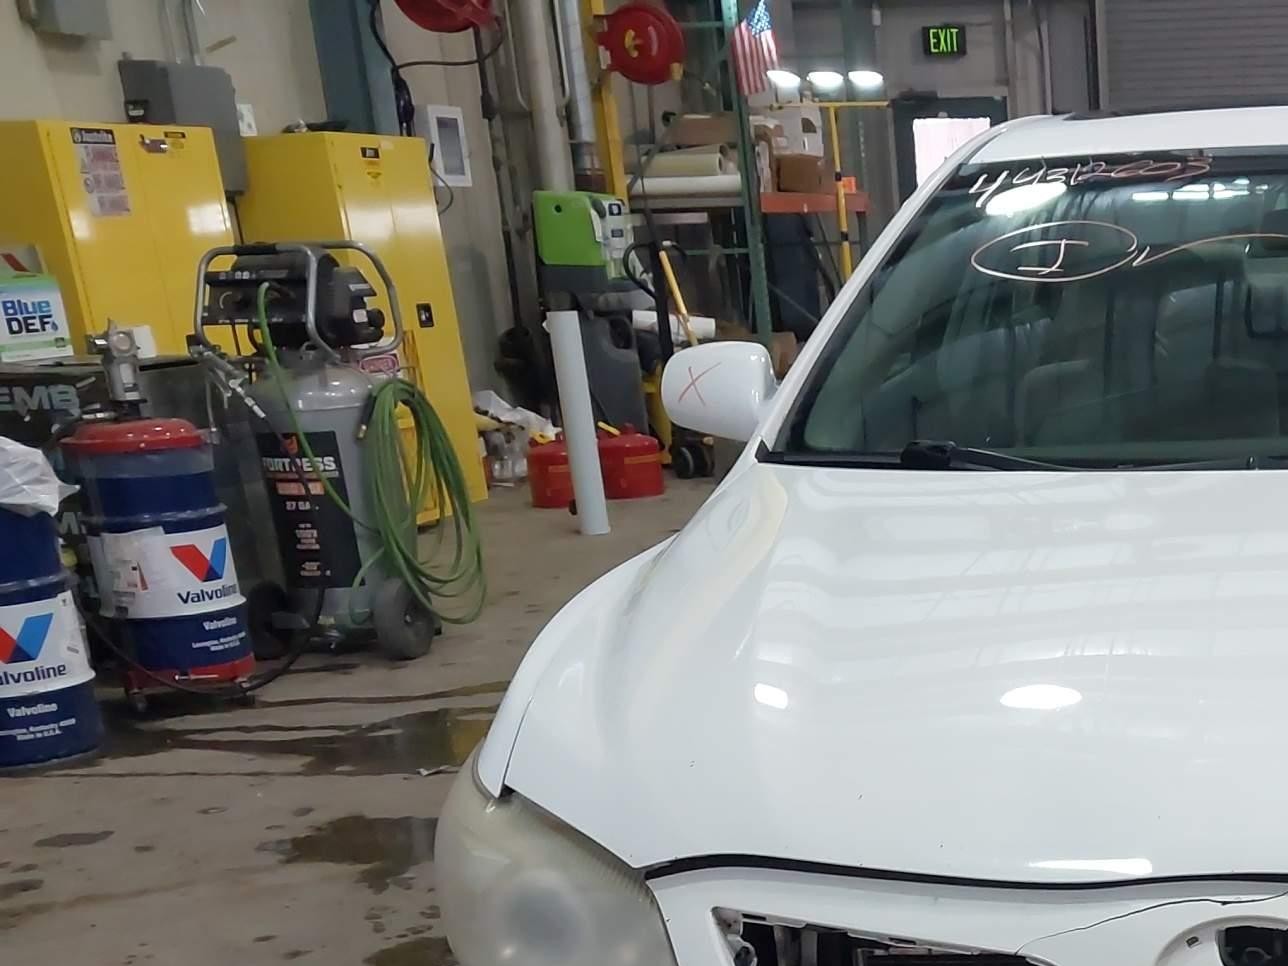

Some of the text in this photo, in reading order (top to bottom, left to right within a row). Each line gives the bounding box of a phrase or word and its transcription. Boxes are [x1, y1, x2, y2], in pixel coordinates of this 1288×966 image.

[929, 28, 960, 53] EXIT
[2, 299, 52, 317] Blue
[5, 314, 53, 335] DEF
[177, 583, 238, 605] Valvoline
[0, 663, 67, 686] lvoline
[7, 703, 58, 718] Valvoline
